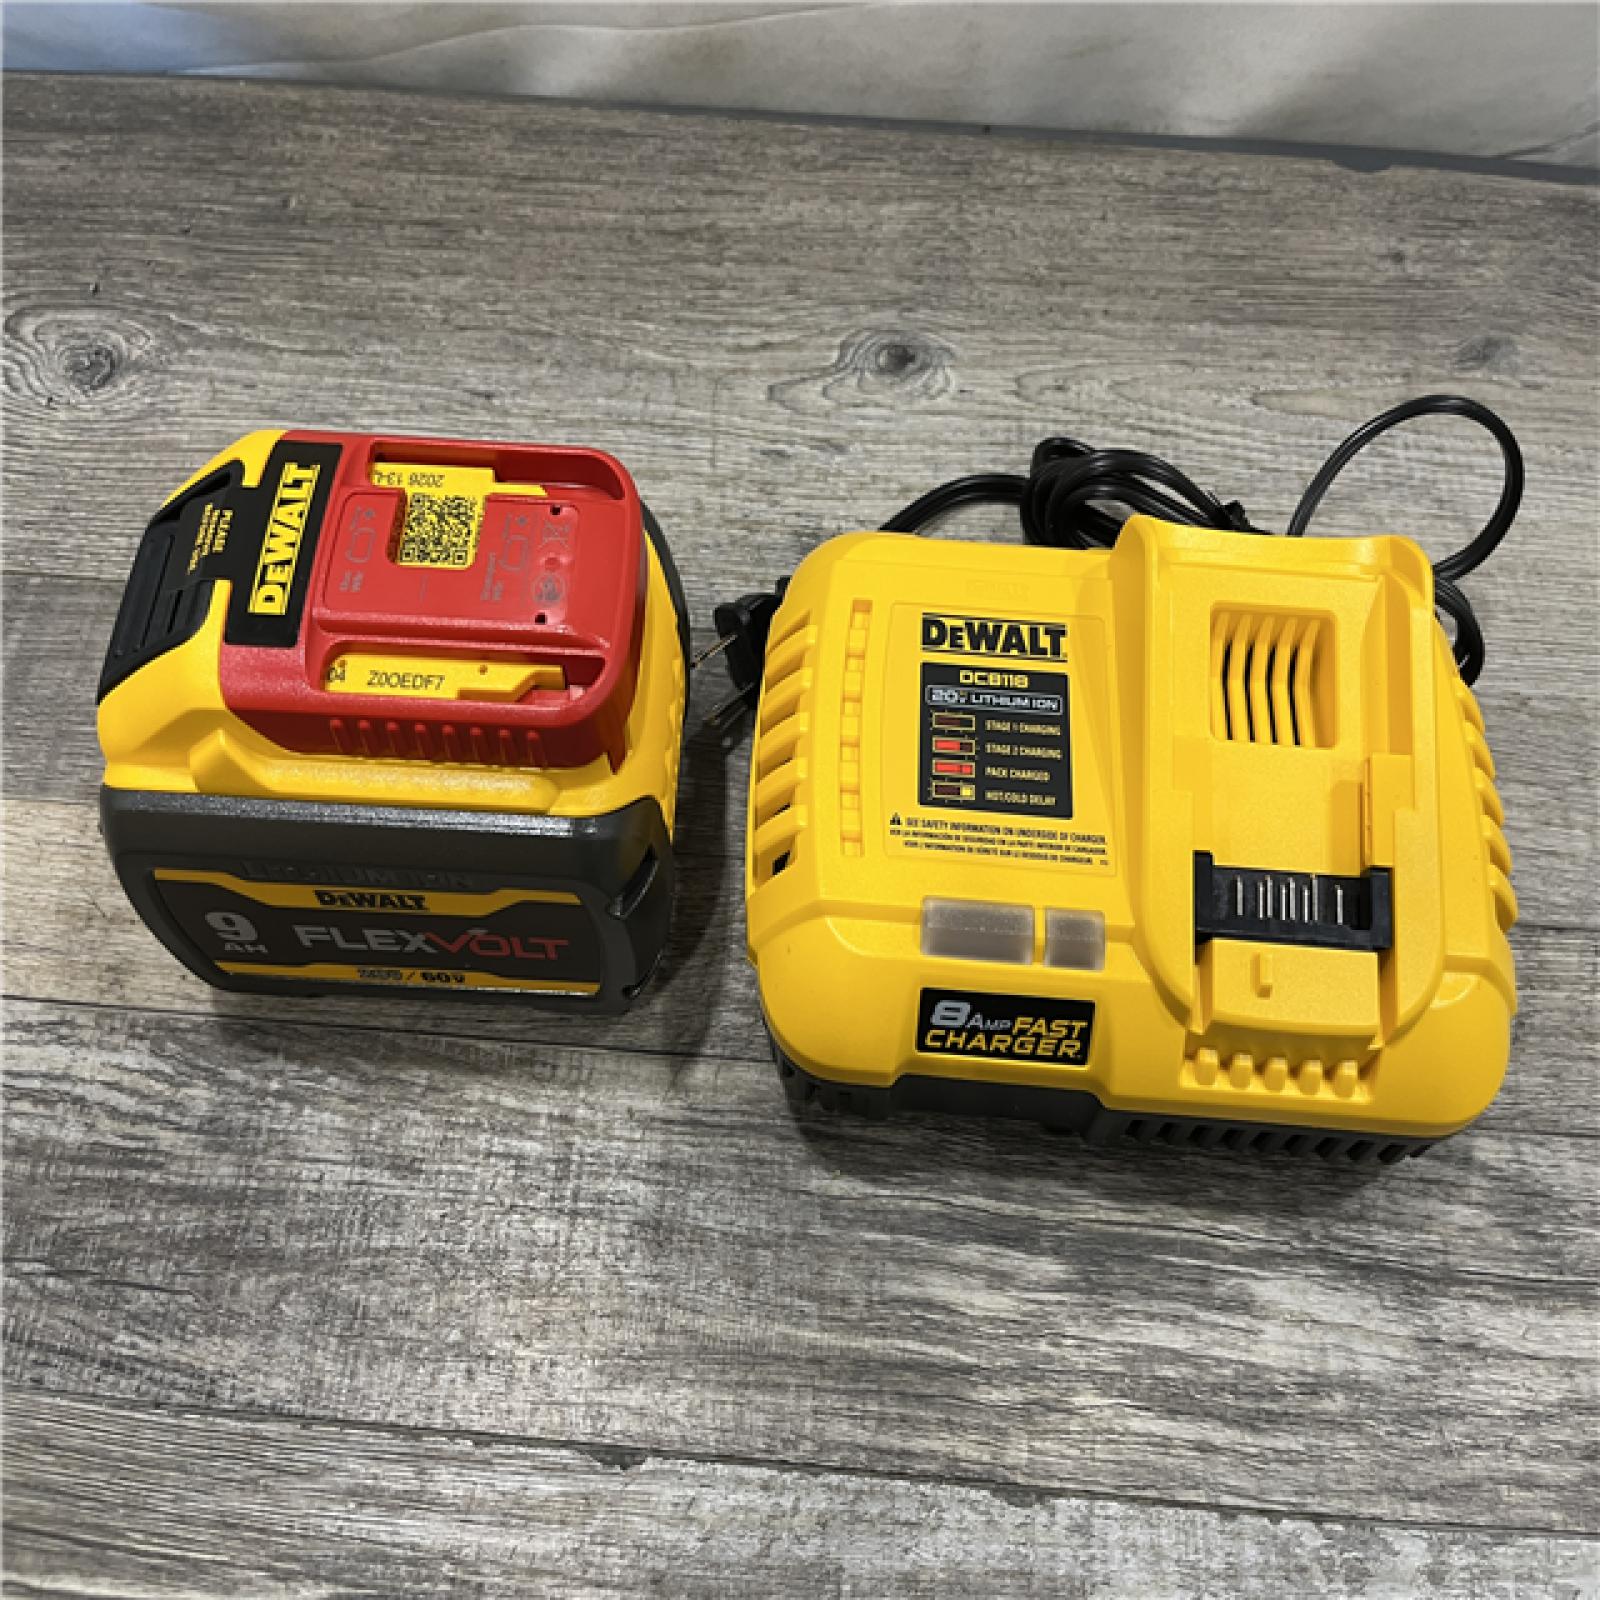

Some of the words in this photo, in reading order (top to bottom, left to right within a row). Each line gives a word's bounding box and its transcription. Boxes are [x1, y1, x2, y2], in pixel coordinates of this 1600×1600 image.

[248, 462, 321, 615] DEWALT
[922, 613, 1068, 660] DEWALT
[971, 694, 1030, 707] LITHIUM
[1031, 698, 1059, 711] ION
[984, 719, 1011, 732] STAGE
[1020, 722, 1062, 736] CHARGING
[984, 743, 1011, 755] STAGE
[1020, 745, 1063, 760] CHARGING
[984, 767, 1008, 778] PACK
[1009, 769, 1052, 783] CHARGED
[315, 889, 430, 911] DEWALT
[205, 911, 258, 942] 9
[293, 923, 570, 961] FLEXVOLT
[1012, 1015, 1089, 1040] FAST
[923, 1029, 1083, 1059] CHARGER
